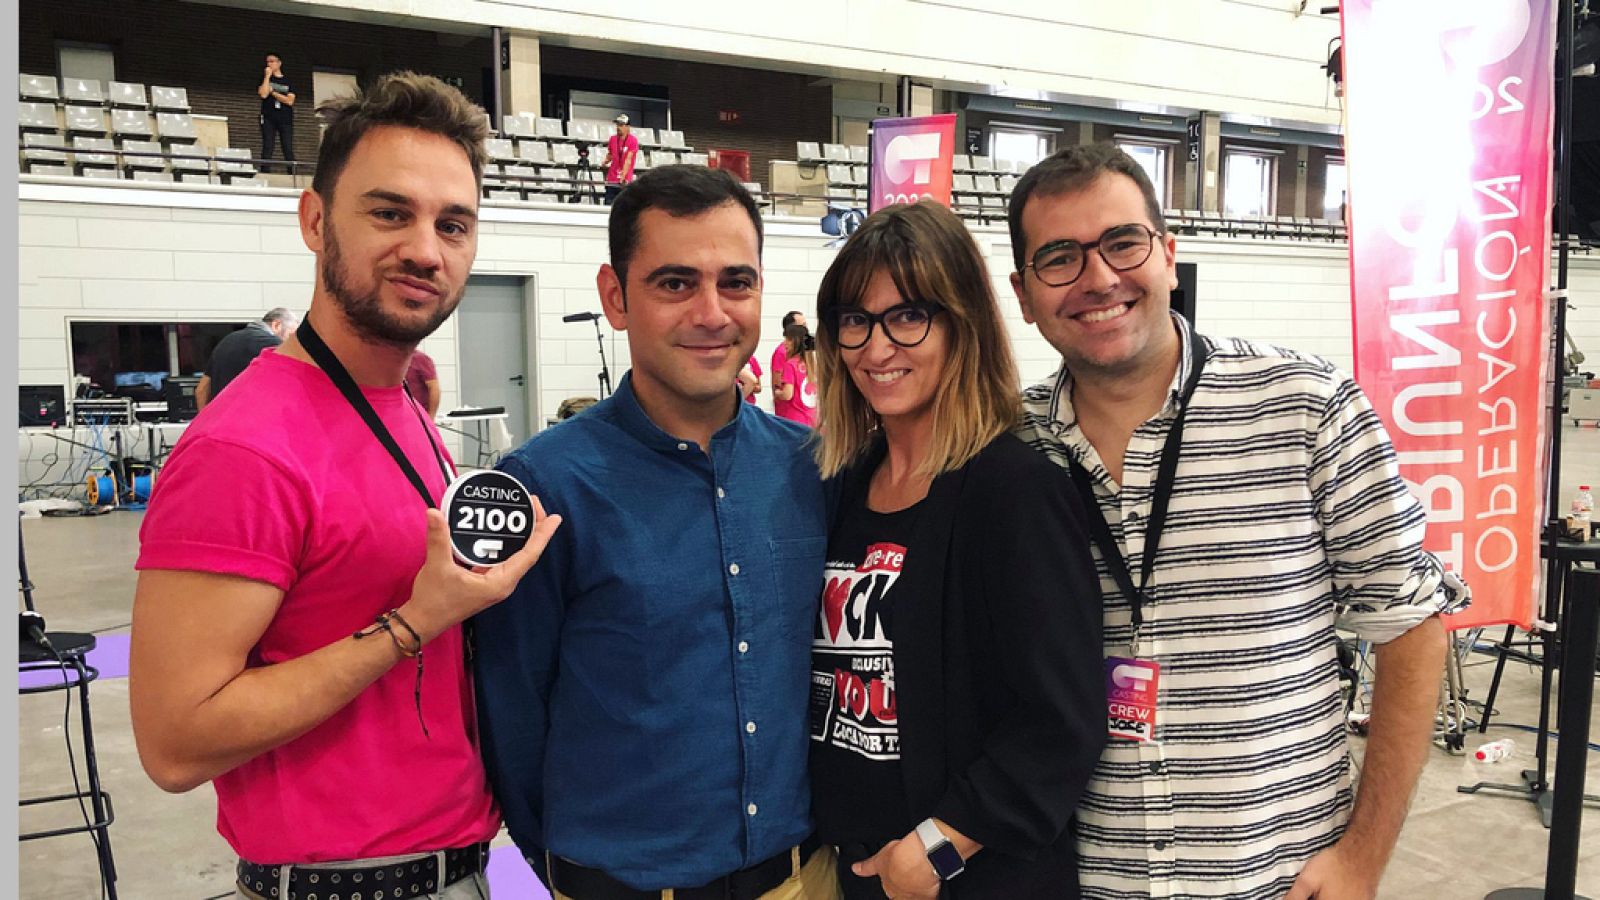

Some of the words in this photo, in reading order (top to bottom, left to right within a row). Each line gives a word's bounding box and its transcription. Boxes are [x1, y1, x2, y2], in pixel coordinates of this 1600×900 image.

[463, 485, 520, 502] CASTING
[457, 505, 527, 534] 2100
[1108, 703, 1151, 720] CREW
